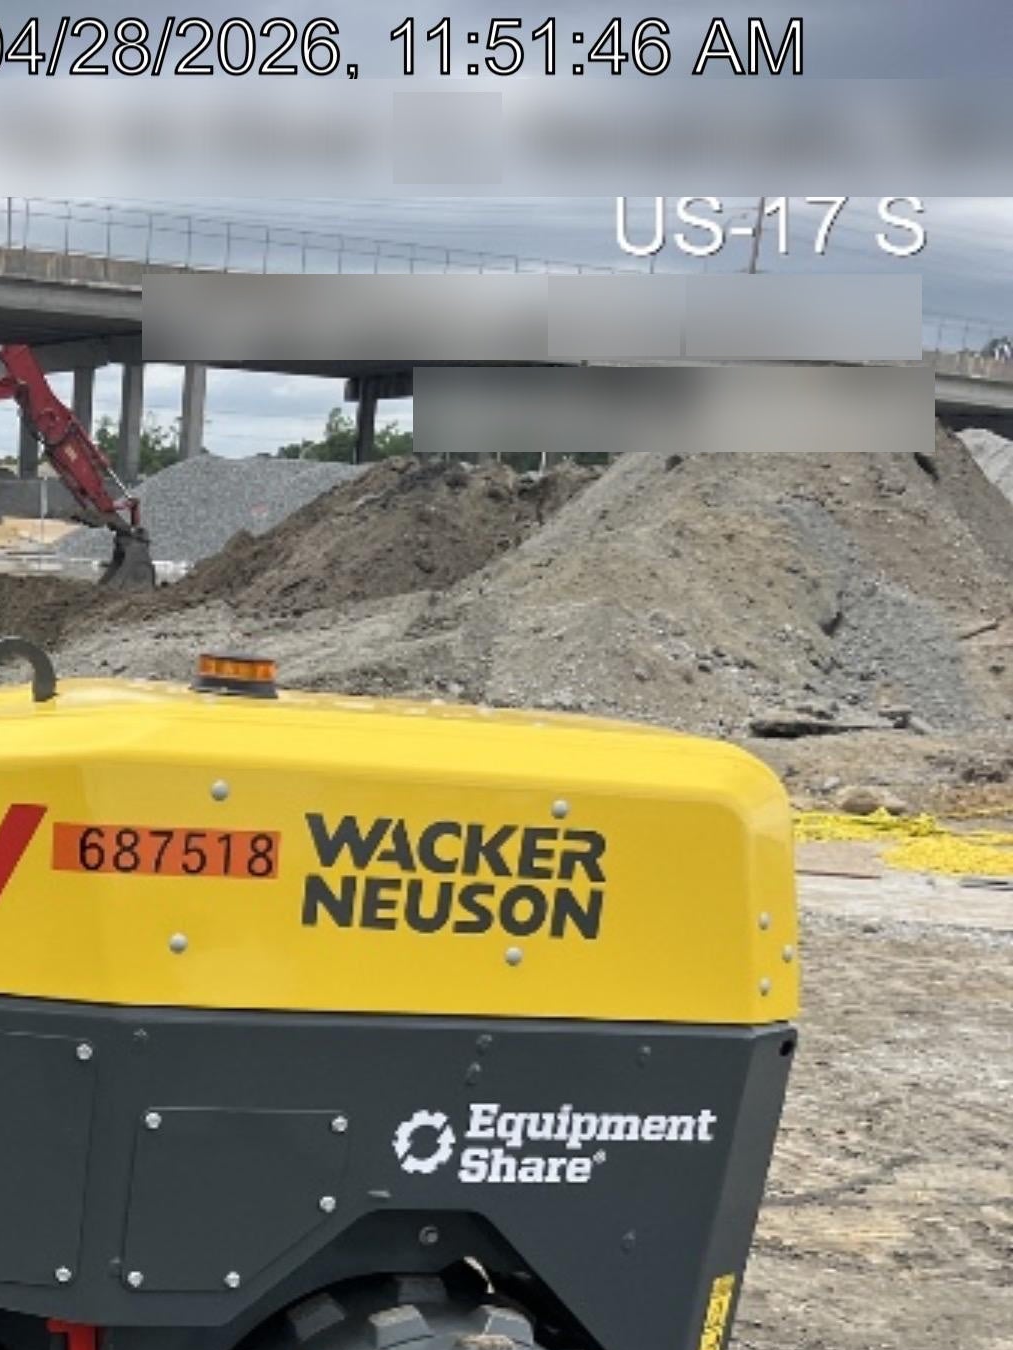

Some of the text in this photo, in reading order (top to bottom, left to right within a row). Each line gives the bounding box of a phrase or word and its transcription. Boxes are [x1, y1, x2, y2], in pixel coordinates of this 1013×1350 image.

[78, 827, 275, 877] 687518
[304, 812, 607, 882] WACKER
[301, 874, 604, 939] NEUSON
[465, 1103, 717, 1149] Equipment
